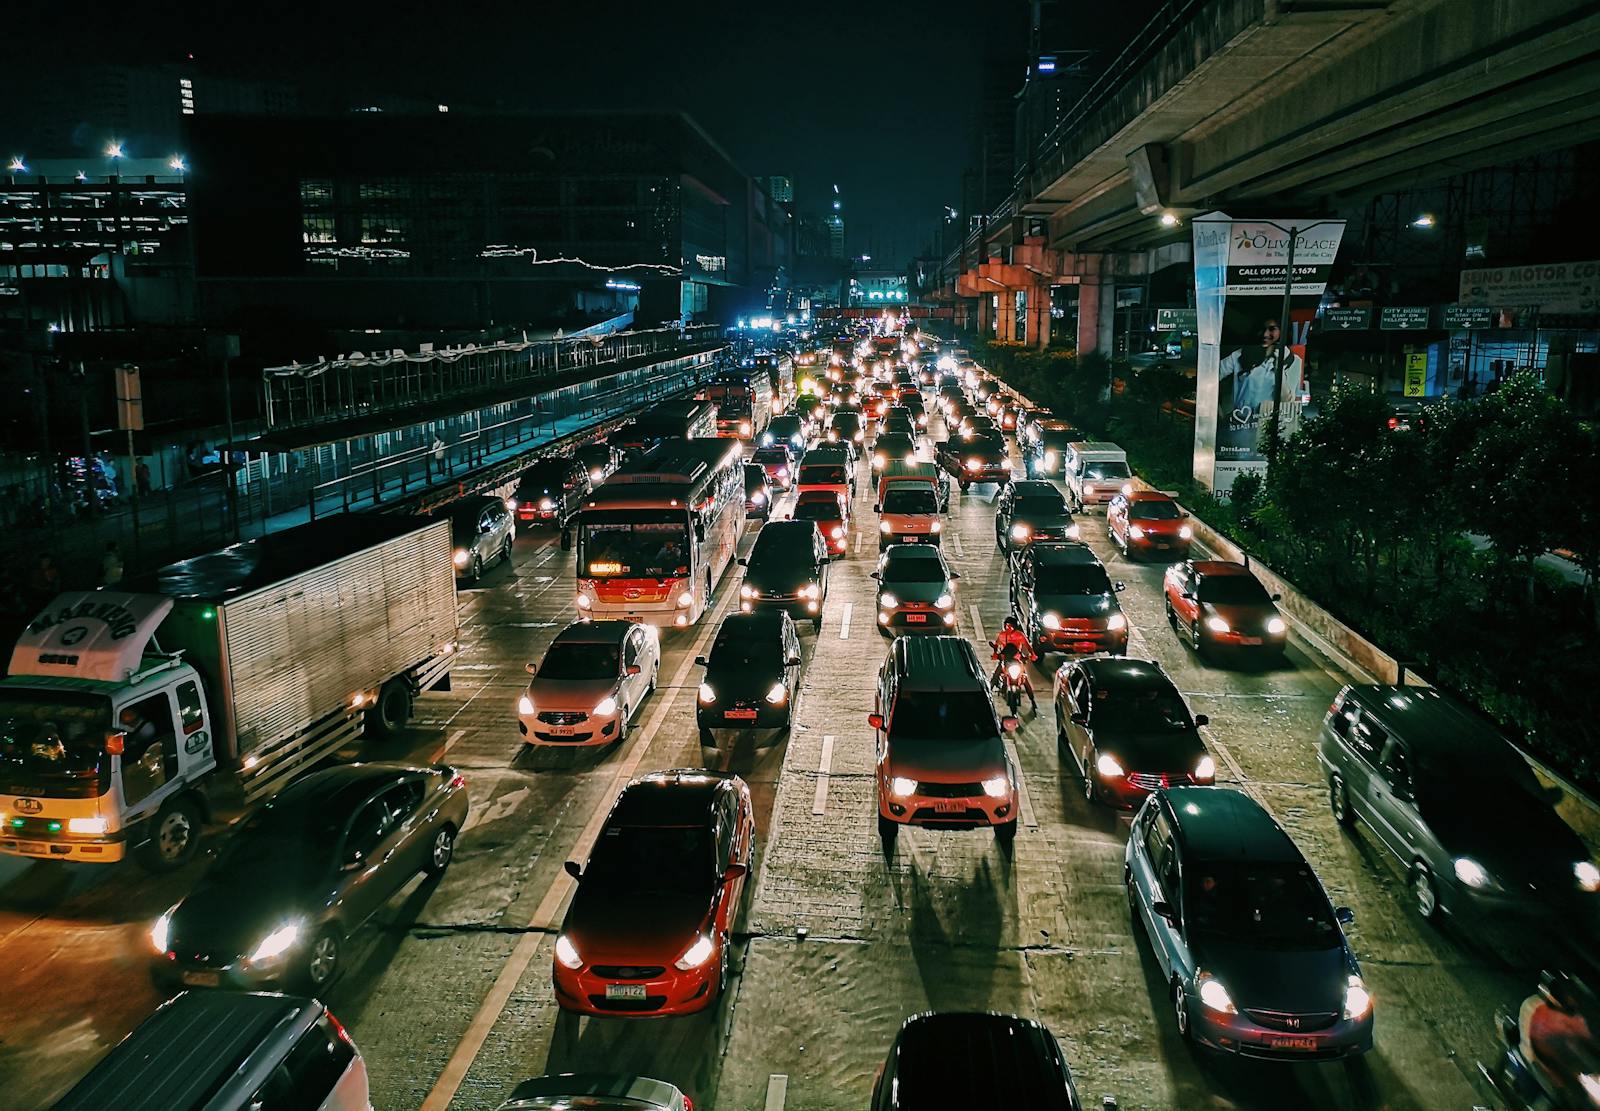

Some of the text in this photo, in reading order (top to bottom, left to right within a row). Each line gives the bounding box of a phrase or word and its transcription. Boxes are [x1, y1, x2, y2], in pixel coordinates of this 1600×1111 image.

[1253, 235, 1337, 249] OLIV PLACE
[1260, 267, 1317, 275] 0917.69.1674
[1509, 266, 1567, 281] MOTOR
[1573, 262, 1600, 278] CO
